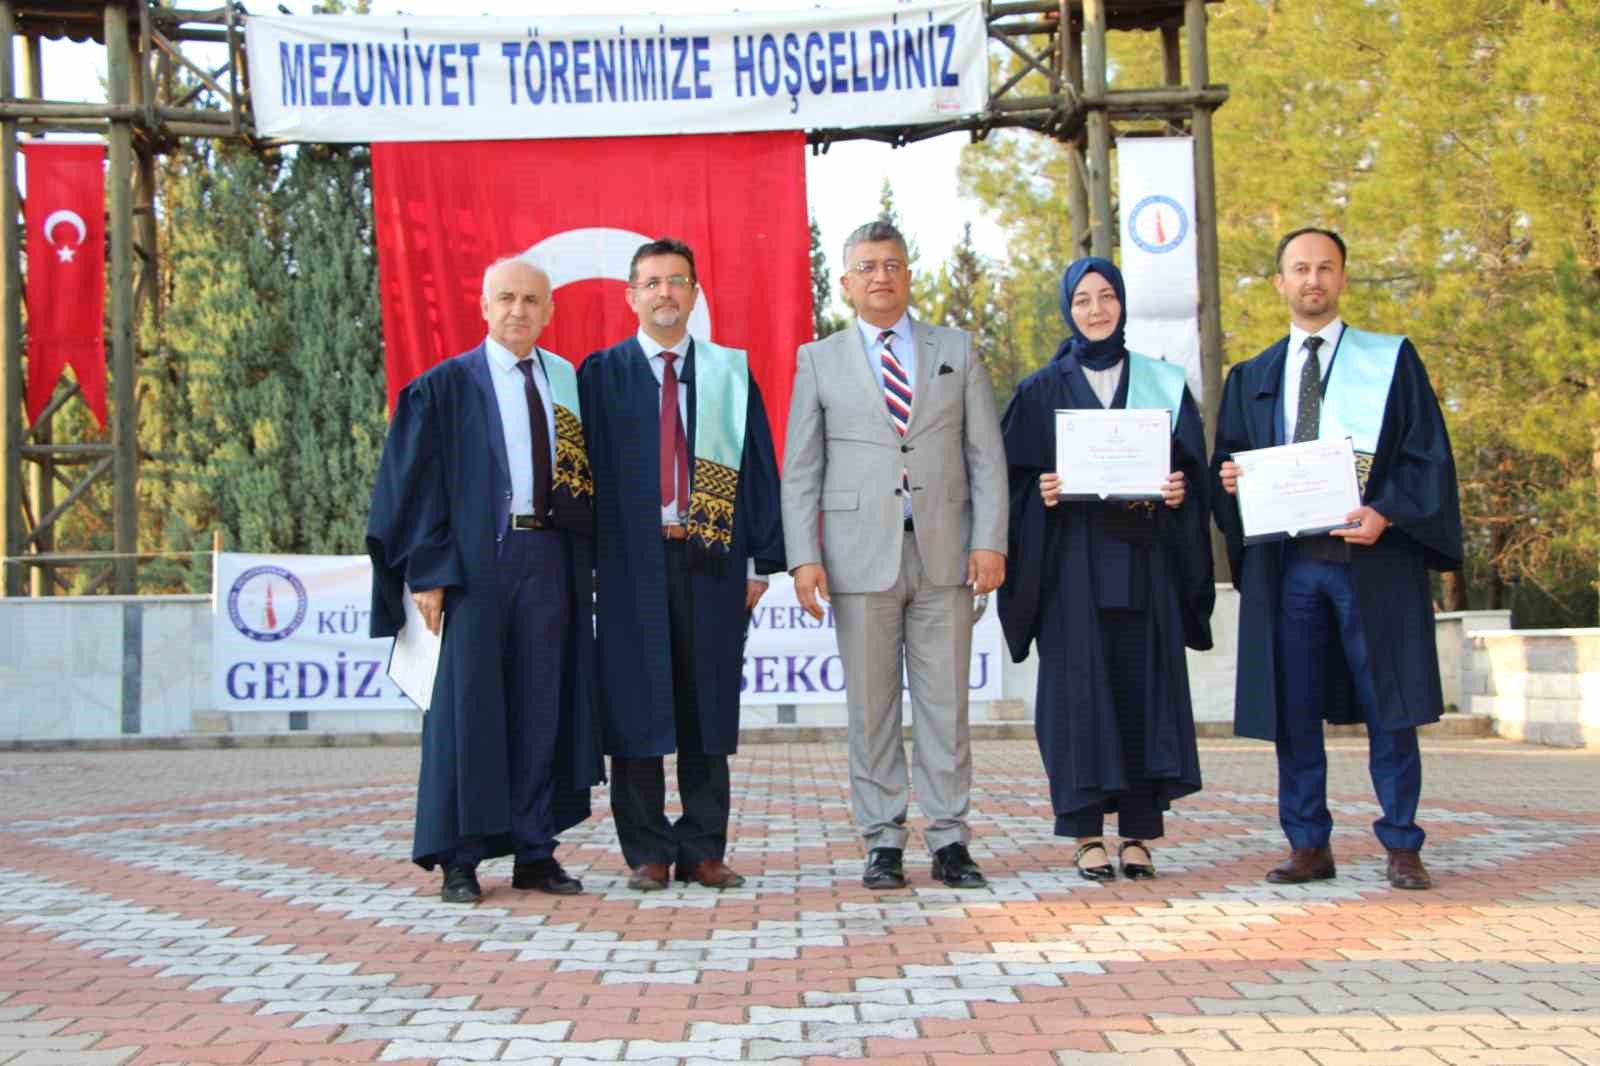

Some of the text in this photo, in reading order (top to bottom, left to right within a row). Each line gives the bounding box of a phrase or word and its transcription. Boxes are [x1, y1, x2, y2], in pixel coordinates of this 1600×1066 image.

[279, 11, 960, 113] MEZUNİYET TÖRENİMİZE HOŞGELDİNİZ
[227, 651, 382, 699] GEDİZ
